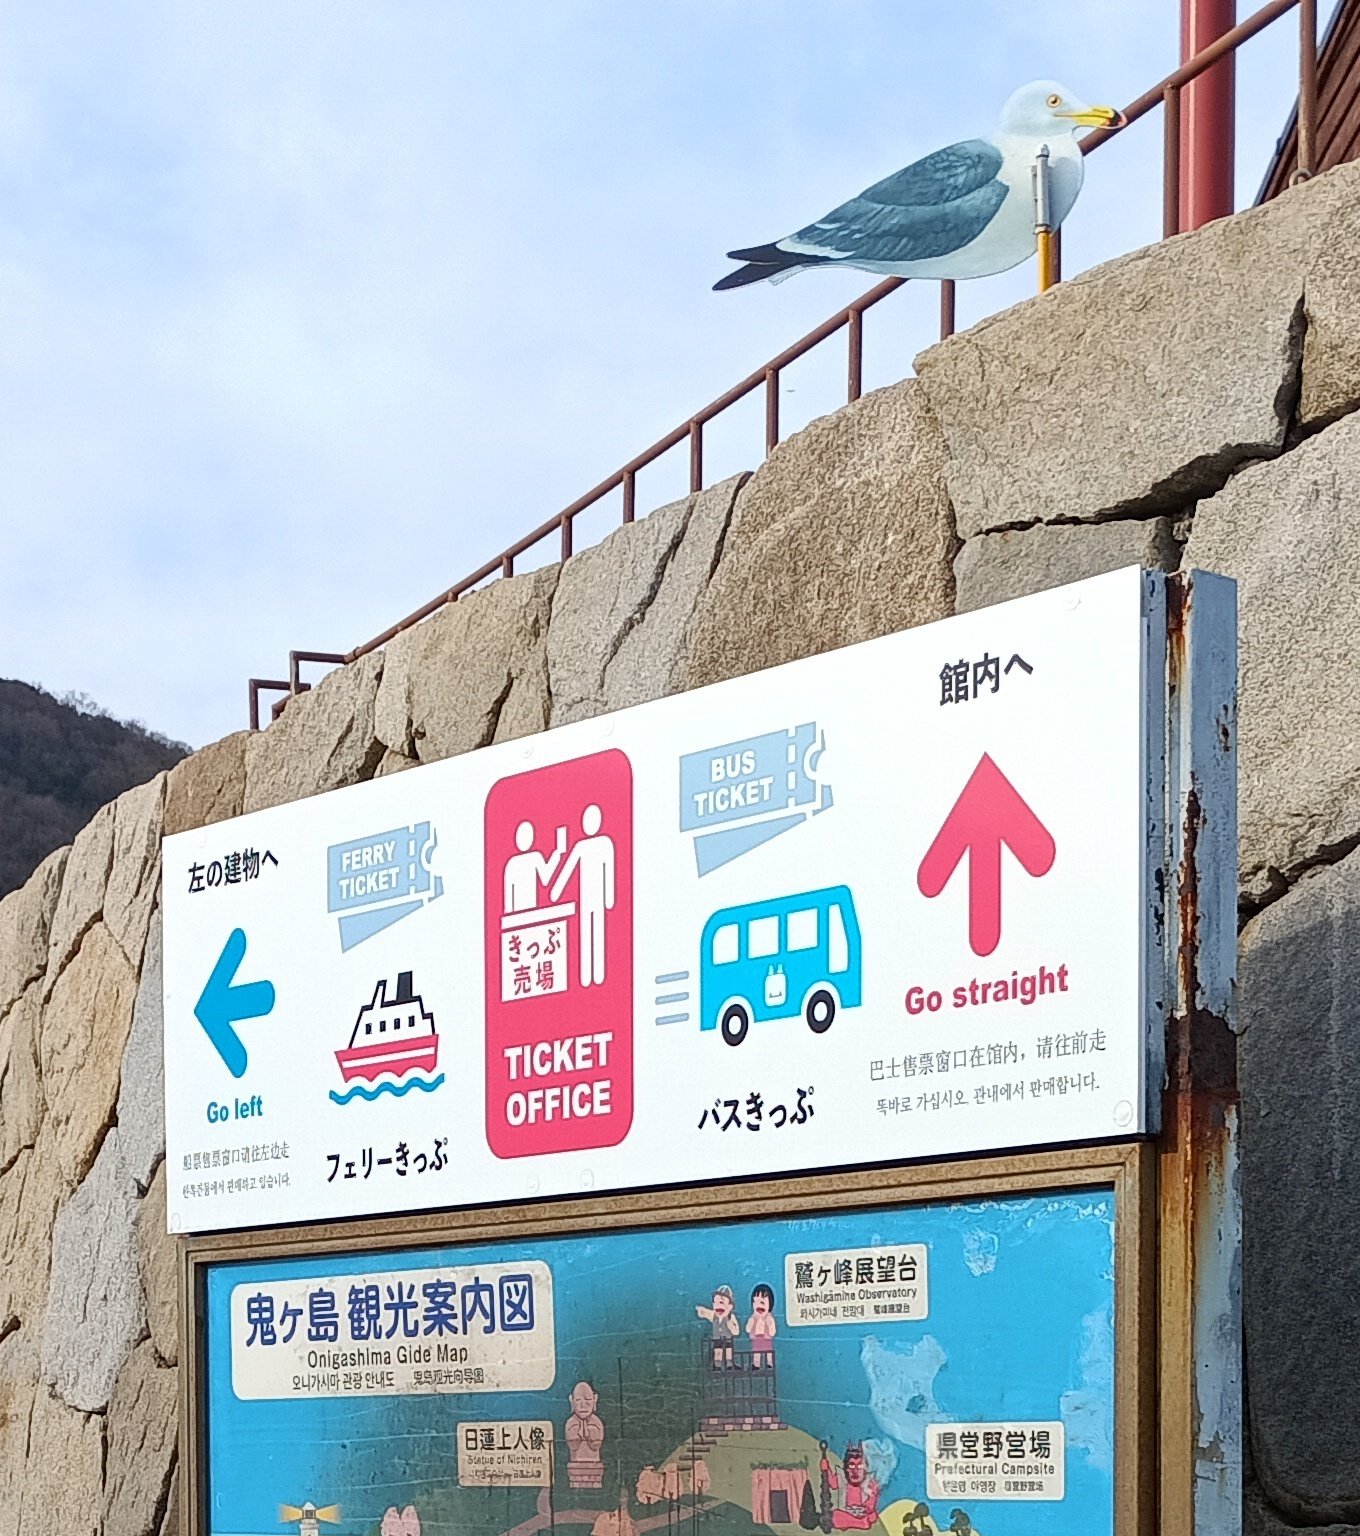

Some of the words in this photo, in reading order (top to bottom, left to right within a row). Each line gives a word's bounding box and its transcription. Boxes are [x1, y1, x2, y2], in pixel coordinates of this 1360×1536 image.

[940, 651, 1034, 706] 館内へ
[710, 750, 756, 781] BUS
[693, 776, 774, 817] TICKET
[187, 847, 279, 893] 左の建物へ
[341, 840, 396, 872] FERRY
[339, 870, 400, 899] TICKET
[507, 927, 562, 963] きっぷ
[512, 962, 554, 994] 売場
[905, 986, 943, 1015] Go
[952, 963, 1069, 1010] straight
[503, 1031, 614, 1080] TICKET
[206, 1100, 229, 1124] Go
[234, 1096, 263, 1120] left
[505, 1079, 612, 1127] OFFICE
[698, 1086, 815, 1132] バスきっぷ
[876, 1096, 912, 1116] 똑바로
[973, 1080, 1024, 1105] 관내에서
[326, 1137, 449, 1183] フェリーきっぷ
[246, 1274, 535, 1347] 鬼ヶ島観光案内図
[858, 1288, 917, 1301] Observatory
[307, 1348, 391, 1370] Onigashima
[397, 1345, 431, 1364] Gide
[437, 1344, 468, 1364] Map
[465, 1426, 545, 1450] 日蓮上人像
[937, 1430, 1051, 1459] 県営野営場
[1002, 1463, 1054, 1476] Campsite
